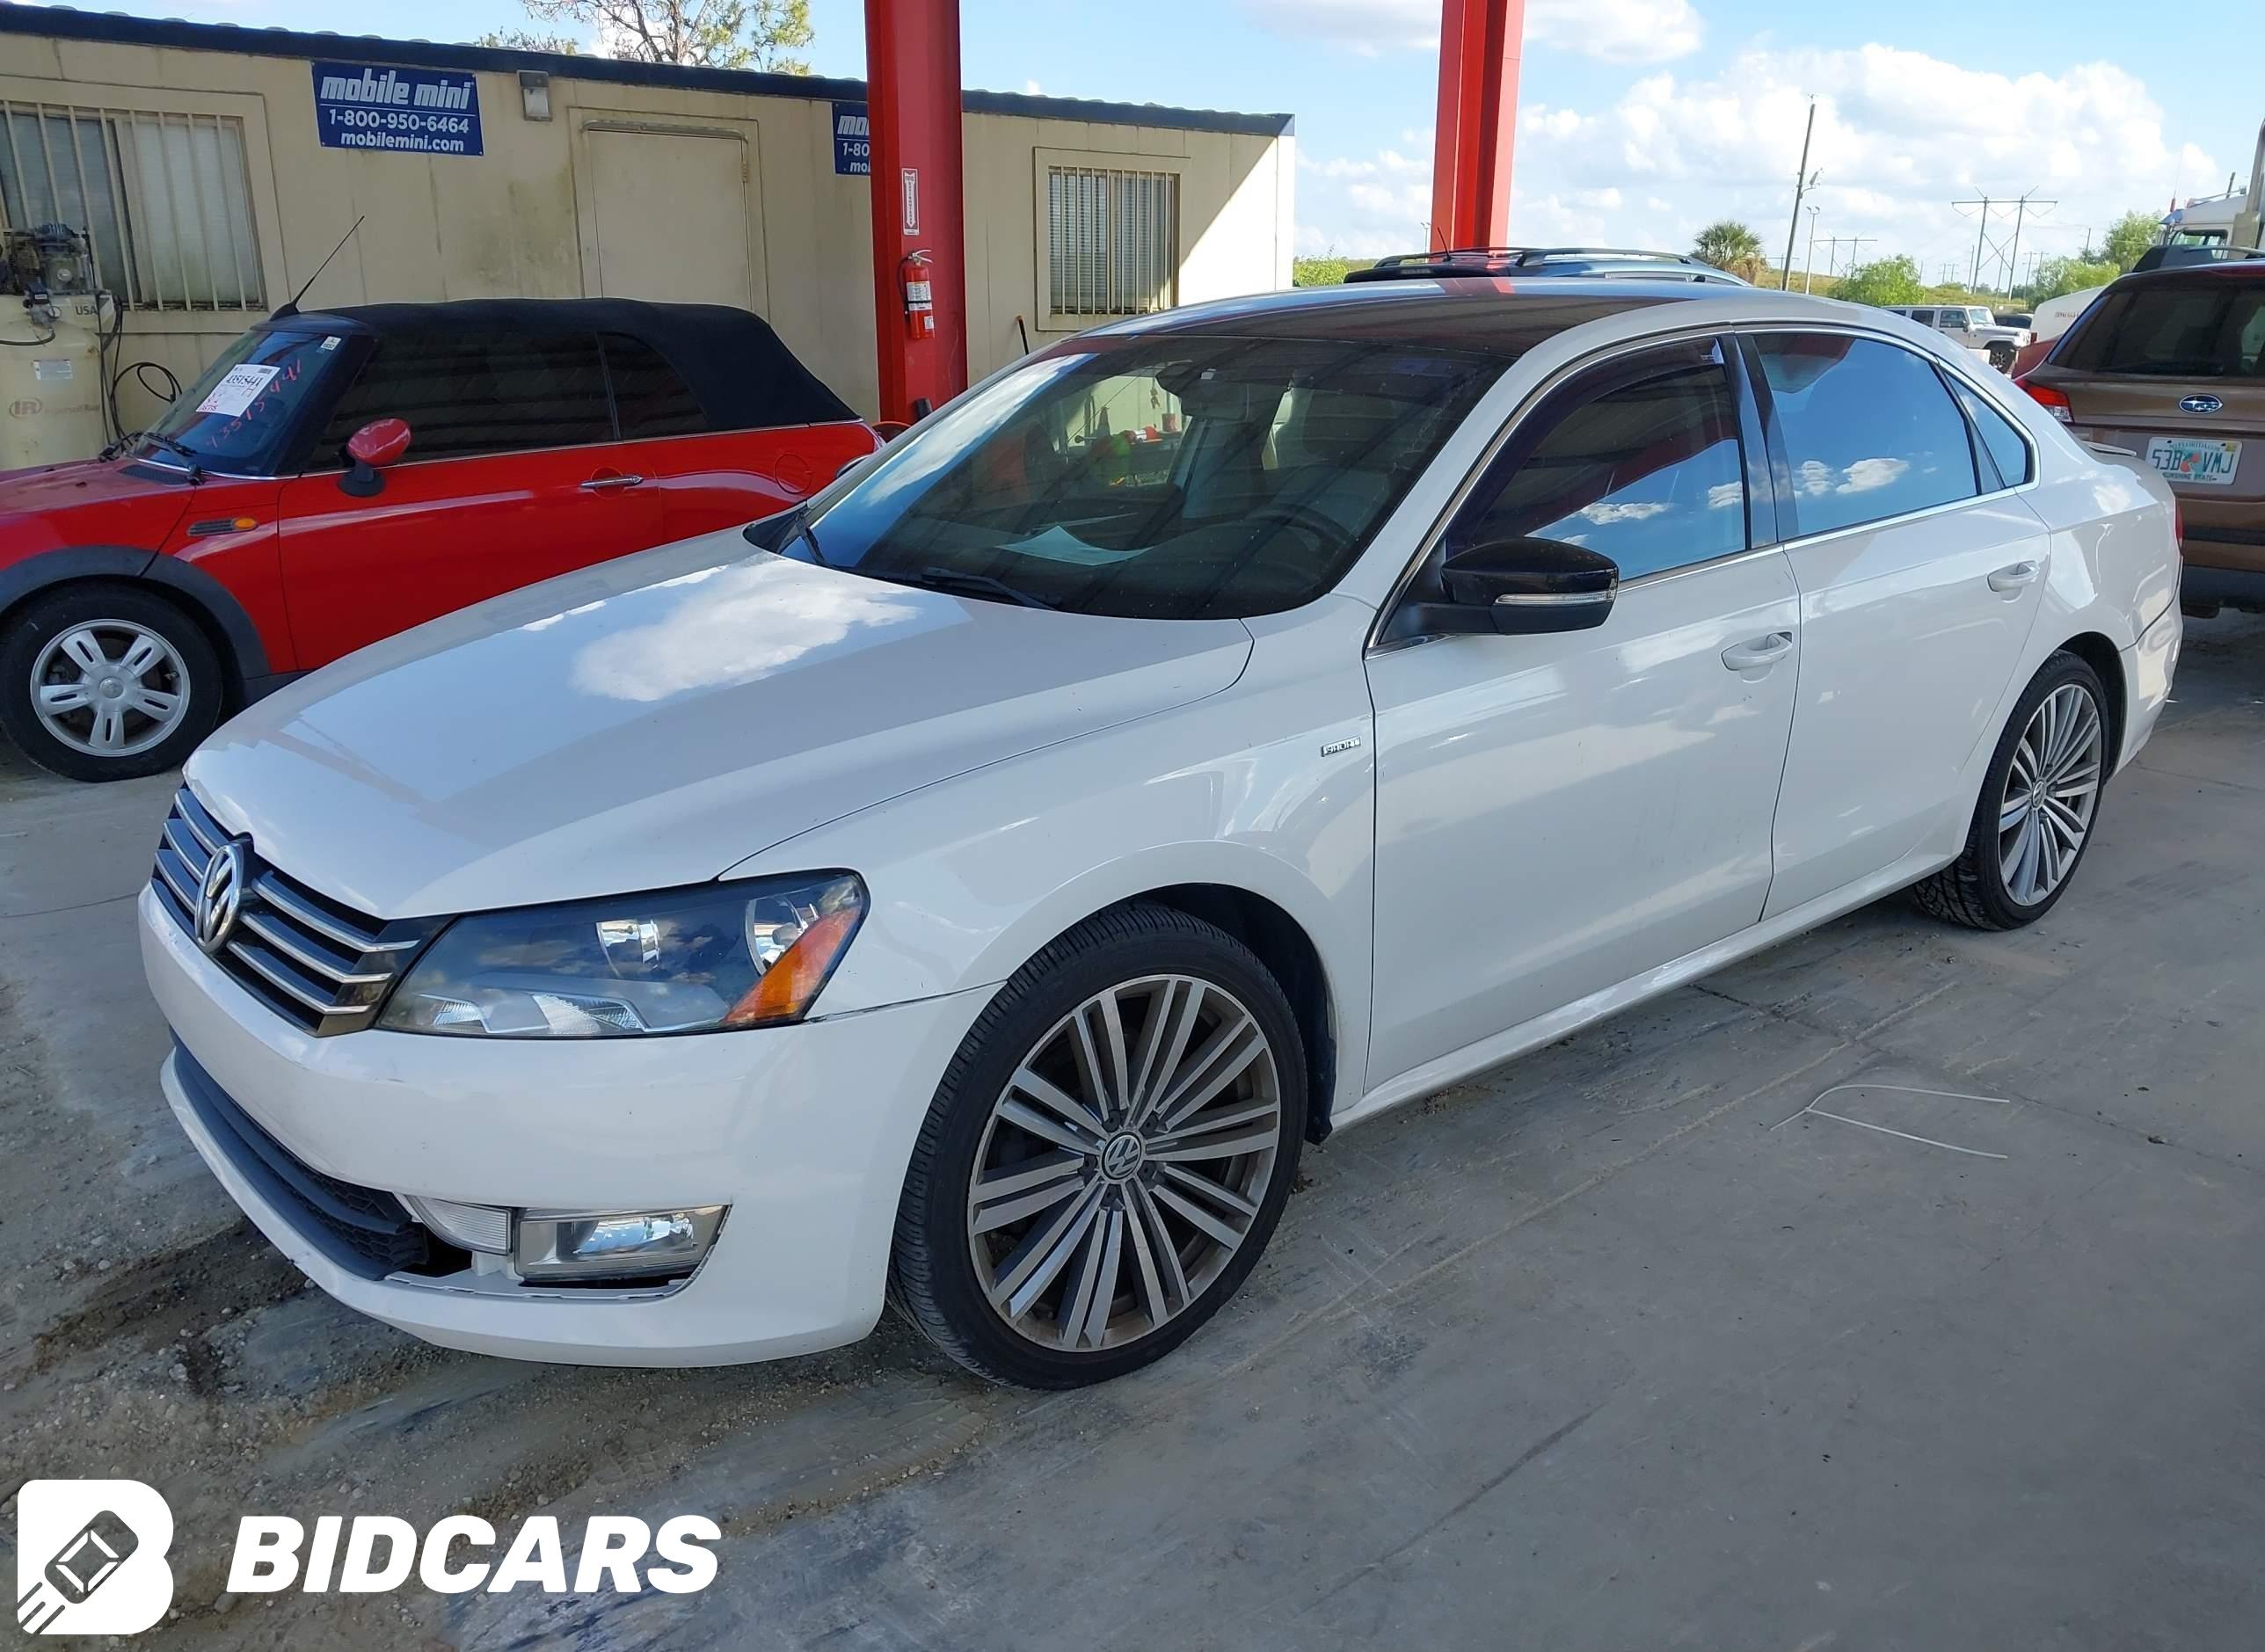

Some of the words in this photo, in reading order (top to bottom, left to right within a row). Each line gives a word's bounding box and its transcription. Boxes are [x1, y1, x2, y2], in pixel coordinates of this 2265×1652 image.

[320, 68, 410, 106] mobile
[413, 79, 471, 110] mini
[329, 108, 470, 134] 1-800-950-6464
[340, 131, 464, 152] mobilemini.com
[75, 304, 98, 316] USA
[2203, 450, 2235, 474] VMJ
